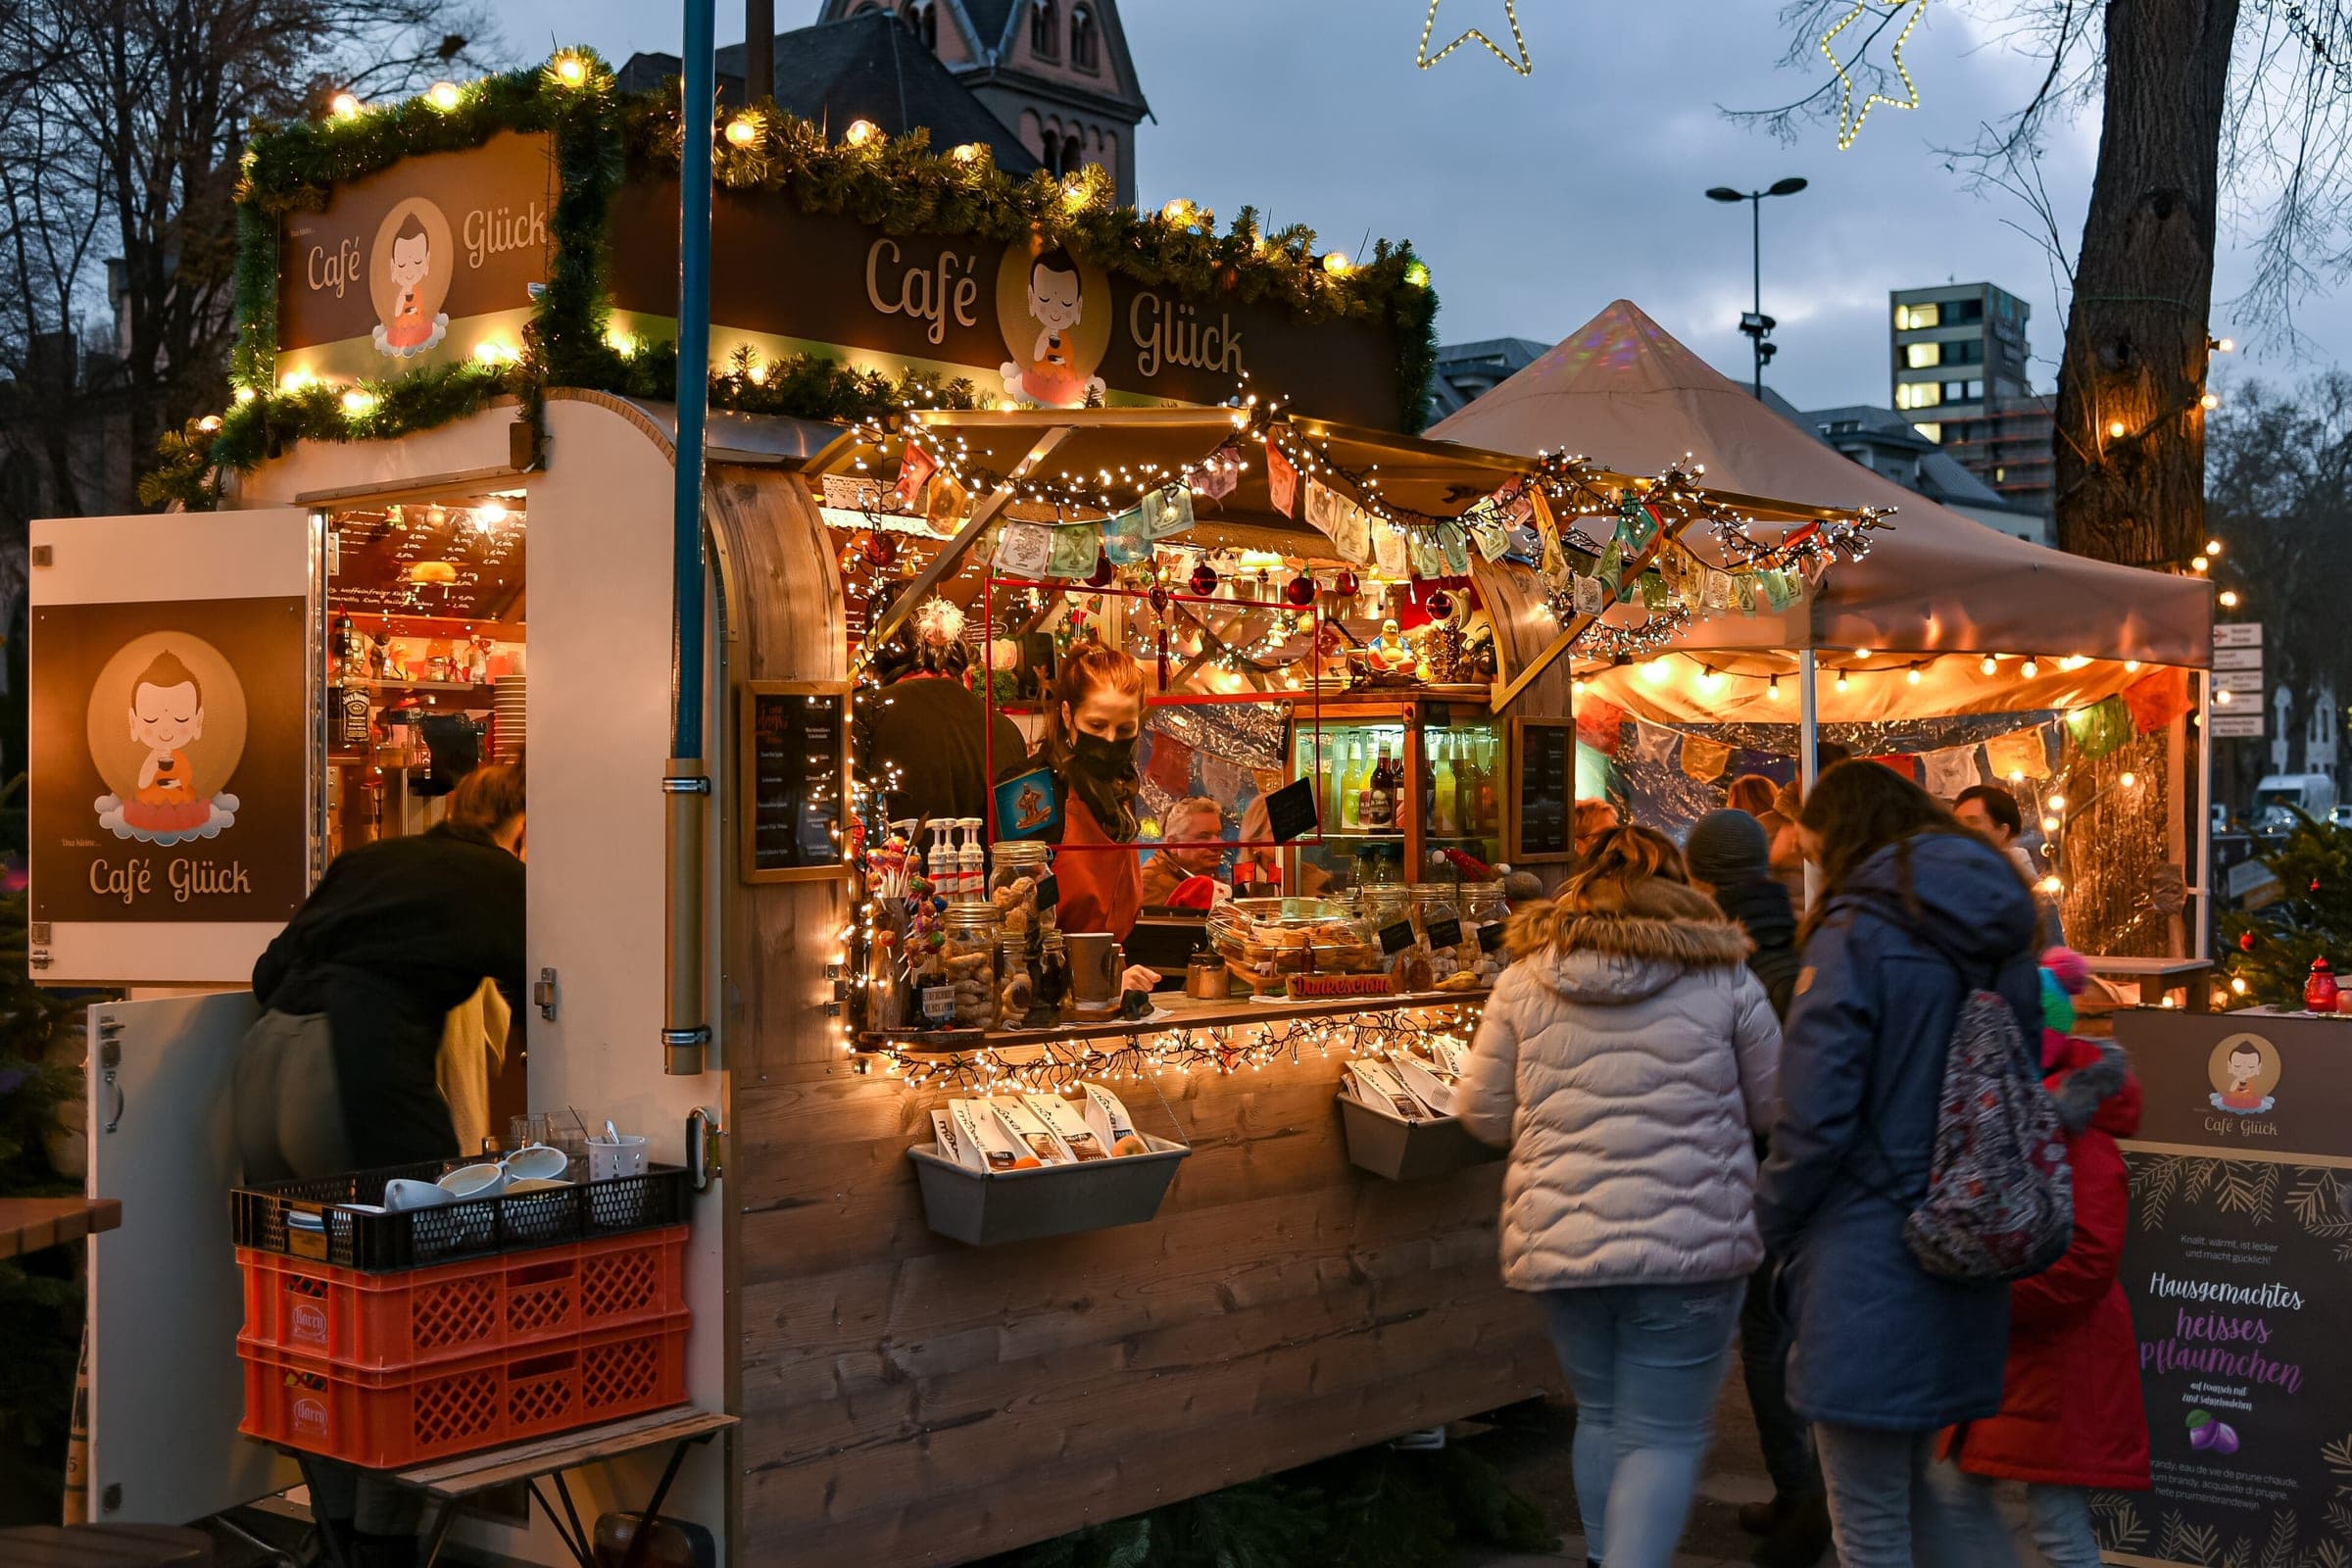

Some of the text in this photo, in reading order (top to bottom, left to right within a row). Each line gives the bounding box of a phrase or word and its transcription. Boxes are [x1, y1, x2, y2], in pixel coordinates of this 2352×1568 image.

[308, 202, 548, 298] Café Glück
[866, 238, 1247, 377] Café Glück
[89, 858, 251, 904] Café Glück
[2204, 1116, 2278, 1137] Café Glück
[2149, 1271, 2305, 1310] Hausgemachtes
[2177, 1306, 2274, 1344] heisses
